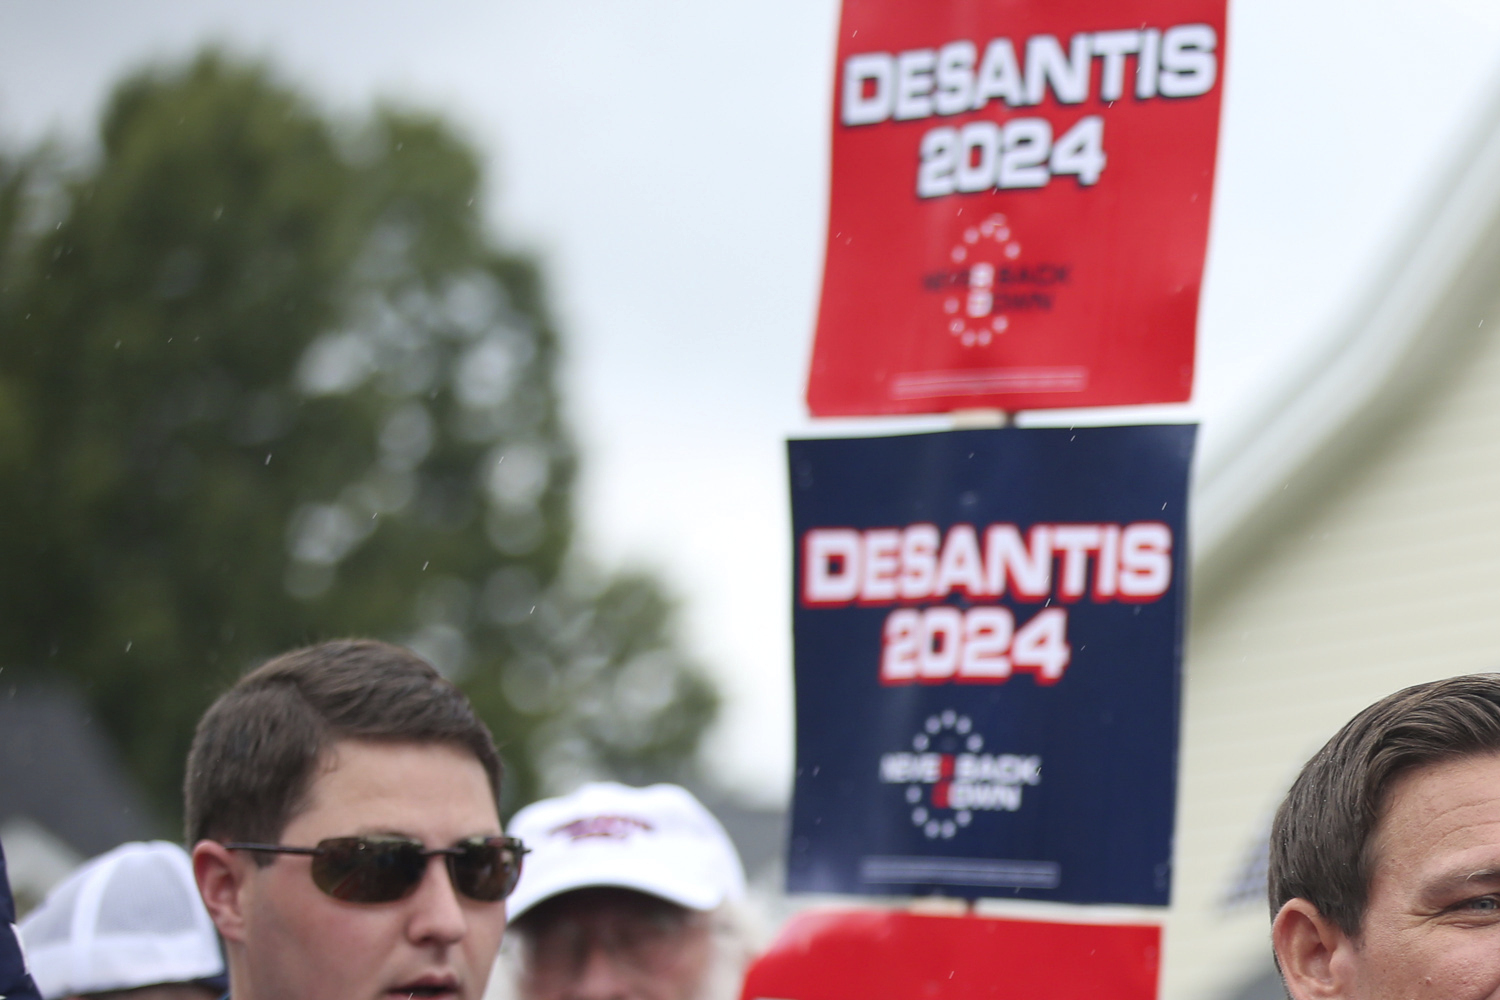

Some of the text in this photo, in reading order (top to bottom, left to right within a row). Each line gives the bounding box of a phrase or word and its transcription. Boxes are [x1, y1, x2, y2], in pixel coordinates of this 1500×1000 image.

[841, 23, 1218, 127] DESANTIS
[917, 115, 1107, 200] 2024
[801, 521, 1174, 609] DESANTIS
[879, 605, 1071, 686] 2024
